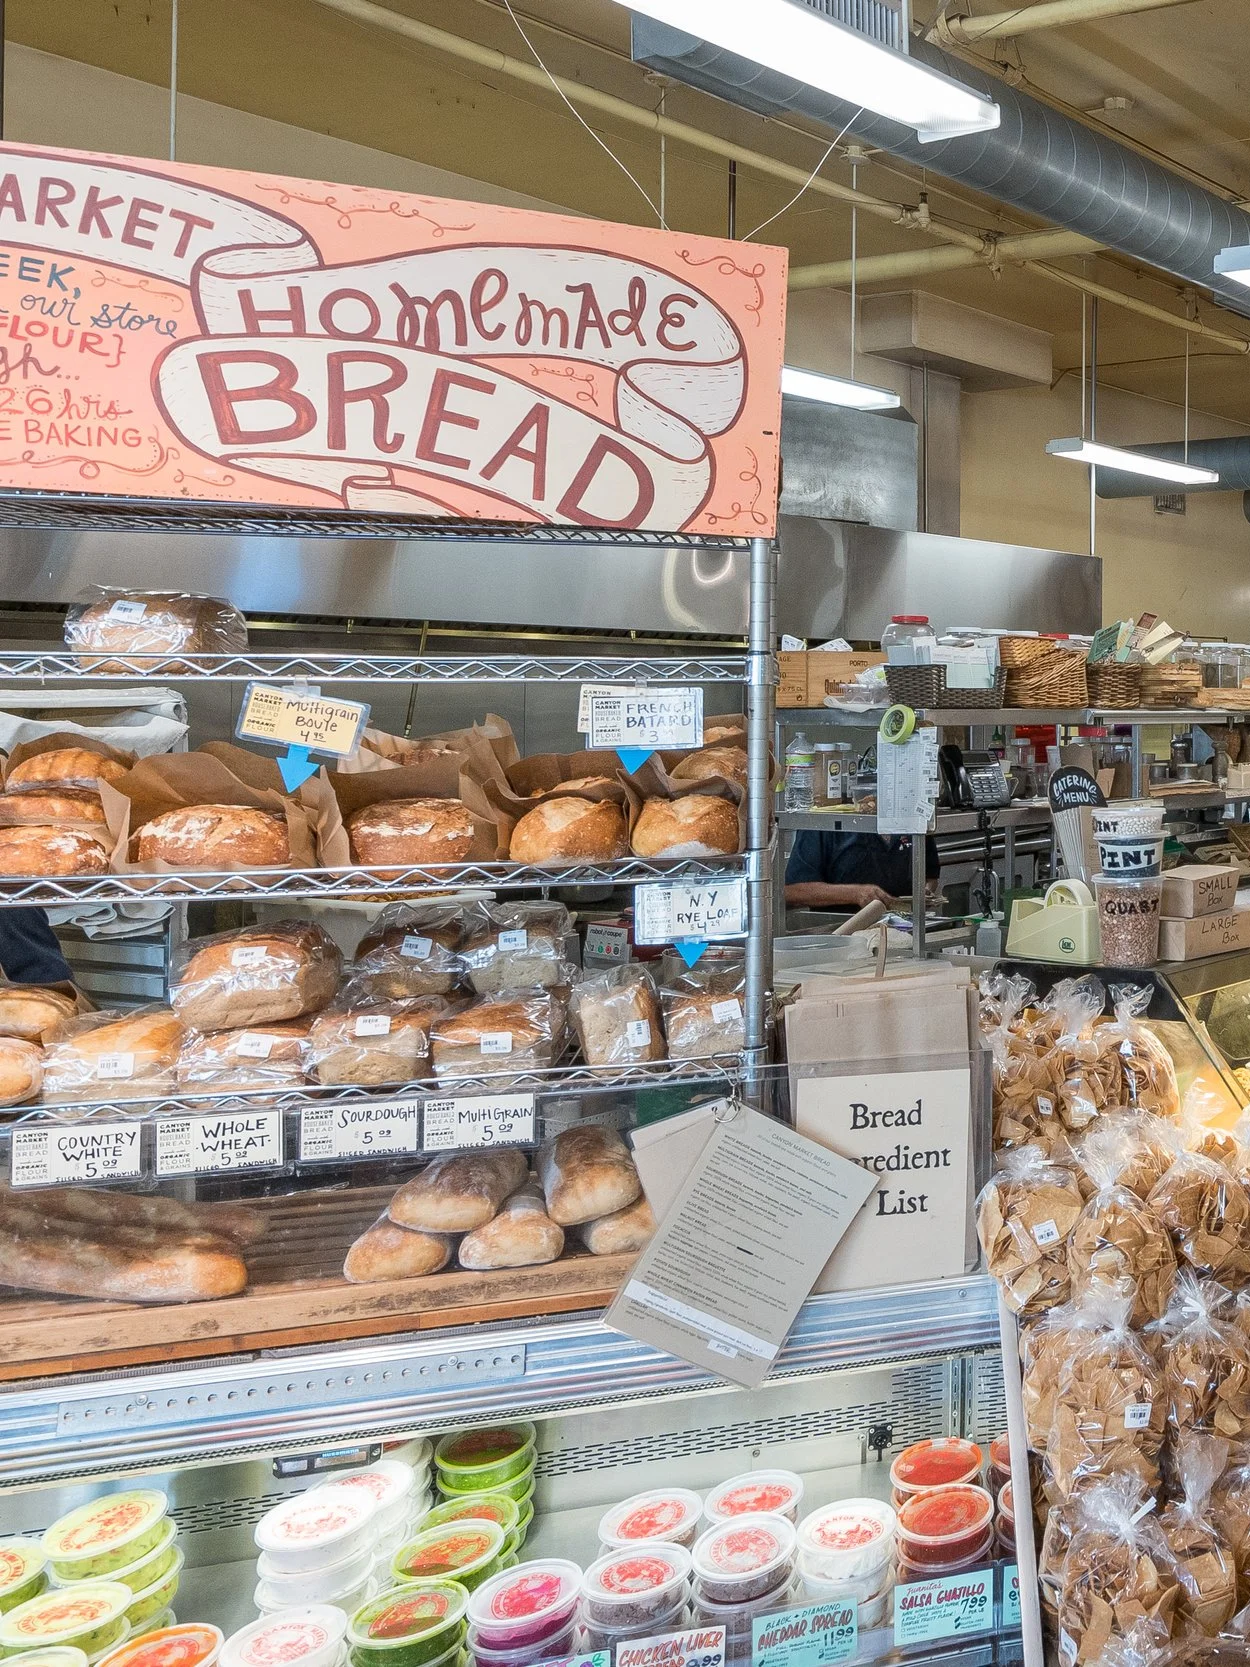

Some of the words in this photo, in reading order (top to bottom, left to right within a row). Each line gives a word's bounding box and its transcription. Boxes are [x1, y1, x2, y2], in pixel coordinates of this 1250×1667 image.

[90, 302, 178, 338] store
[24, 419, 142, 448] BAKING
[197, 350, 655, 530] BREAD
[253, 697, 282, 706] MARKET
[626, 701, 693, 714] FRENCH
[251, 708, 279, 718] BREAD
[626, 714, 692, 728] BATARD
[246, 723, 275, 733] FLOUR
[247, 718, 275, 729] ORGANIC
[1053, 774, 1098, 797] CATERING
[1062, 790, 1090, 804] MENU
[1198, 878, 1232, 895] SMALL
[1105, 899, 1159, 915] QUART
[1207, 892, 1224, 905] Box
[677, 912, 700, 924] RYE
[707, 907, 738, 919] LOAF
[1201, 914, 1239, 935] LARGE
[1222, 932, 1240, 944] Box
[338, 1105, 416, 1128] SOURDOUGH
[850, 1100, 922, 1131] Bread
[202, 1118, 268, 1138] WHOLE
[482, 1124, 493, 1142] 5
[58, 1131, 137, 1151] COUNTRY
[362, 1131, 373, 1144] 5
[492, 1138, 530, 1147] SANDWICH
[62, 1146, 123, 1162] WHITE
[367, 1146, 408, 1156] SANDWICH
[771, 1132, 793, 1147] CANYON
[792, 1144, 814, 1158] MARKET
[812, 1155, 830, 1167] BREAD
[699, 1177, 712, 1186] WHOLE
[712, 1183, 724, 1192] WHEAT
[724, 1189, 738, 1199] BREADS
[876, 1189, 929, 1217] List
[907, 1581, 943, 1595] Juanita's
[900, 1593, 932, 1610] SALSA
[765, 1615, 791, 1631] BLACK
[801, 1603, 841, 1617] DIAMOND
[758, 1620, 807, 1651] CHEDDAR
[809, 1609, 853, 1635] SPREAD
[618, 1637, 684, 1667] CHICKEN
[685, 1631, 724, 1649] LIVER
